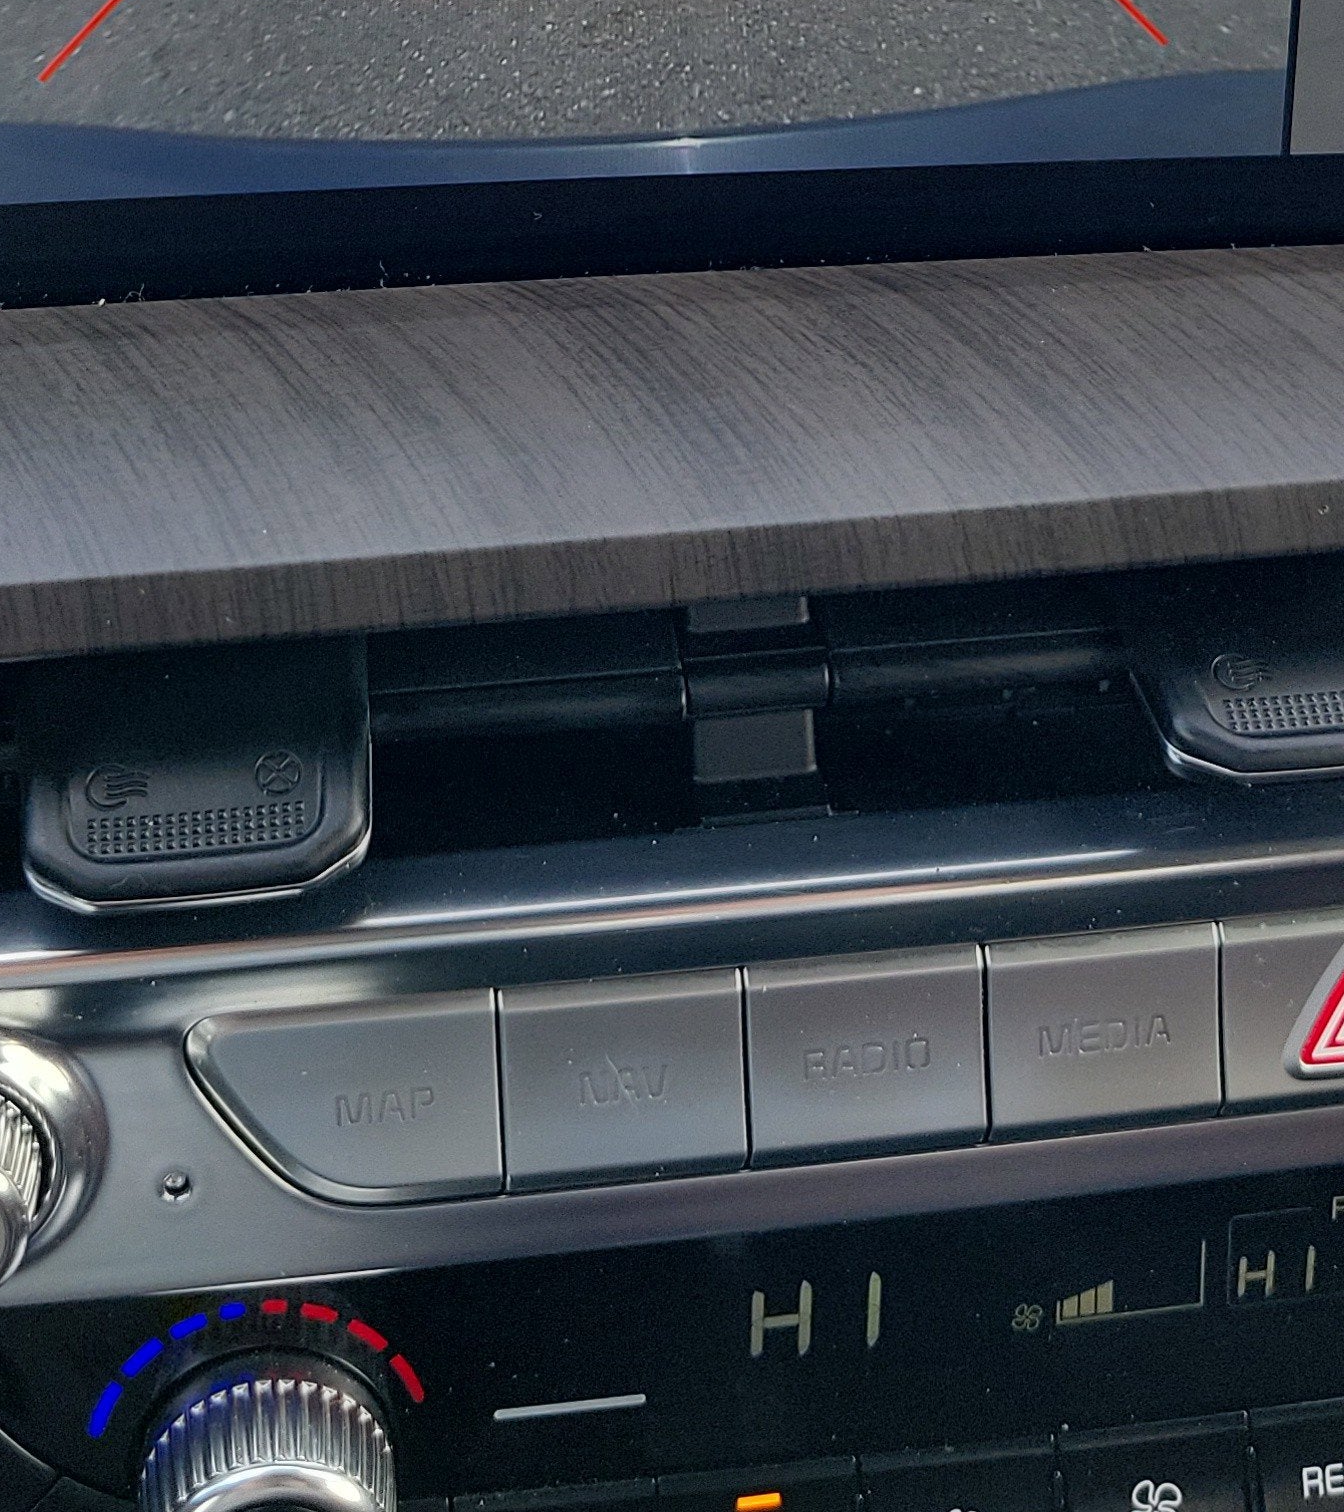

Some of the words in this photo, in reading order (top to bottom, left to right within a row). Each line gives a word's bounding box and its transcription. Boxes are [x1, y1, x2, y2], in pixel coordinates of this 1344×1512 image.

[1038, 1014, 1172, 1058] MEDIA
[803, 1037, 932, 1083] RADIO
[334, 1087, 434, 1127] MAP
[579, 1064, 668, 1107] NAV
